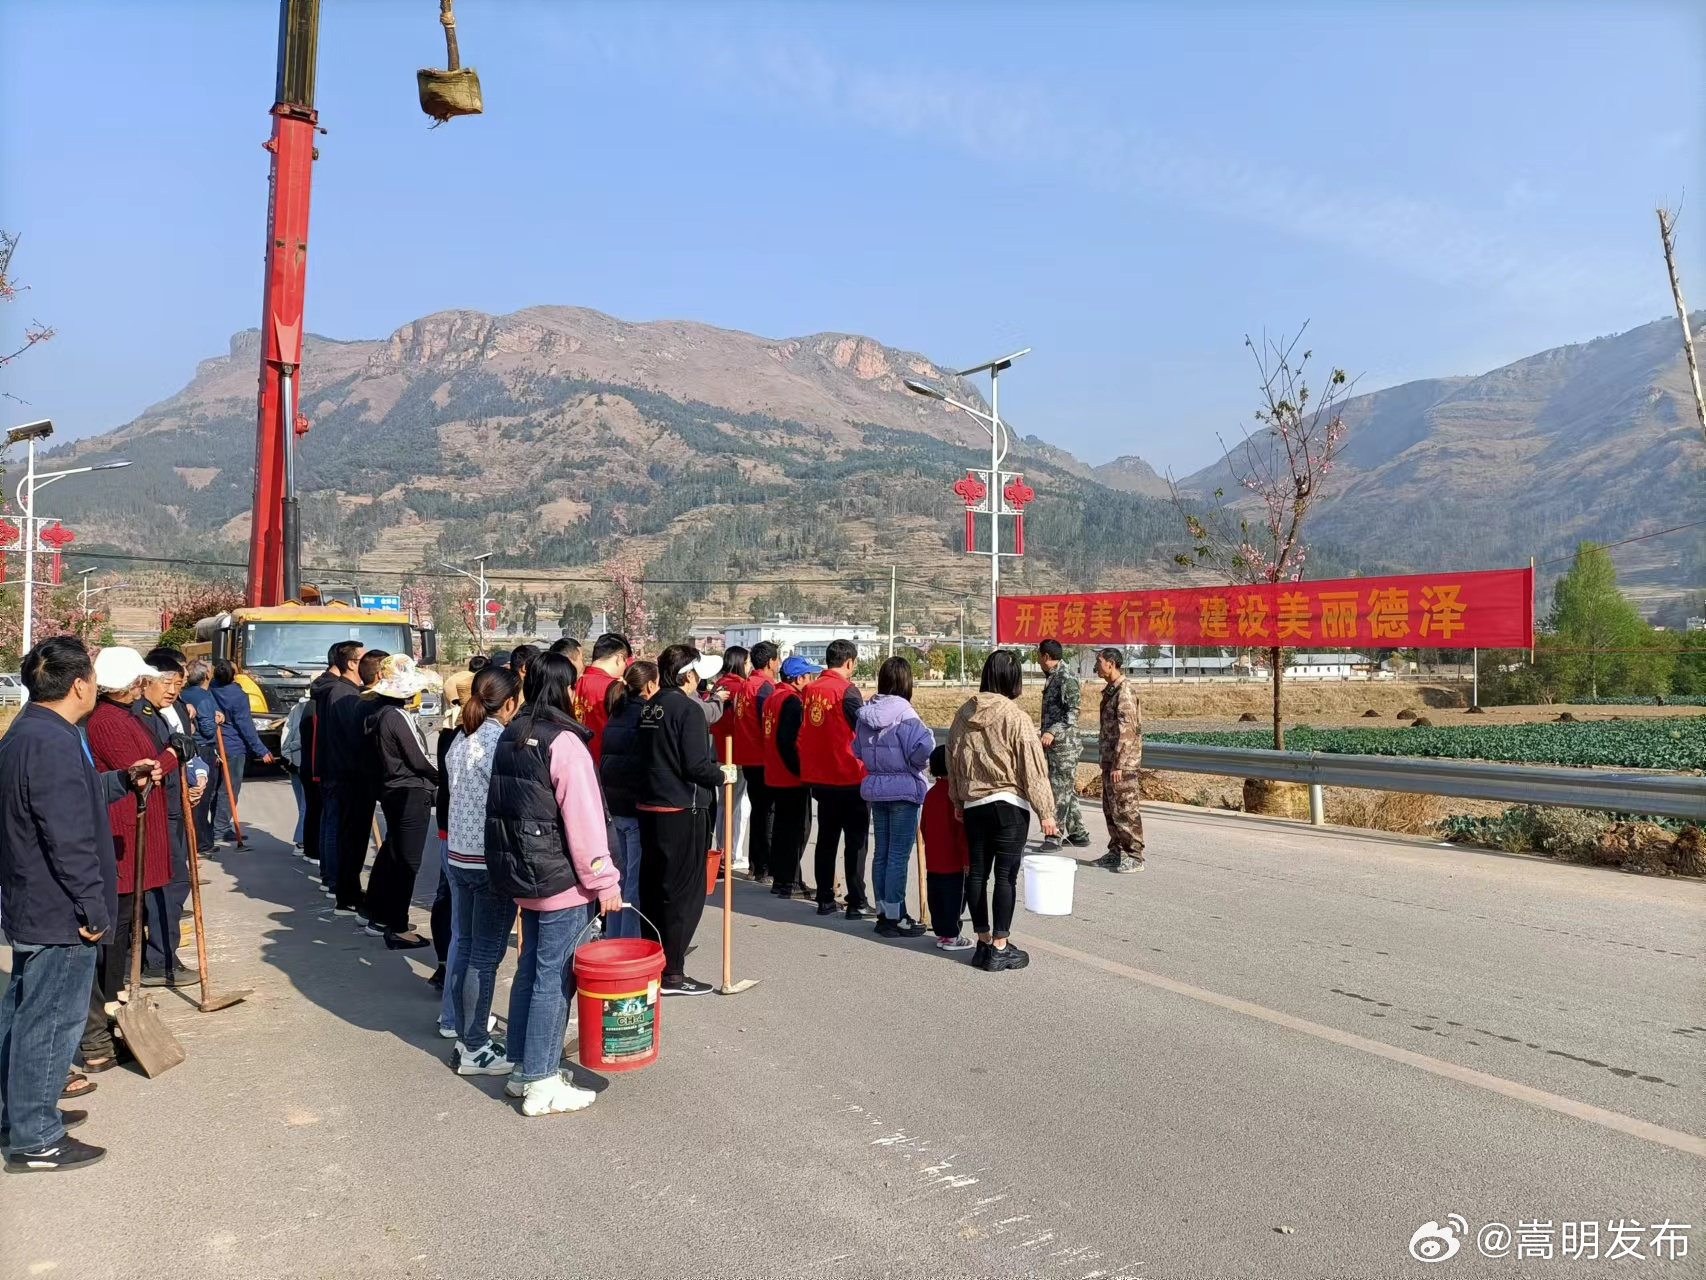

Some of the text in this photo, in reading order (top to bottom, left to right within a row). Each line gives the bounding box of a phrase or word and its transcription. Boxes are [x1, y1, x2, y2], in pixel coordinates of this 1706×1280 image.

[1014, 584, 1468, 640] 开展绿美行动 建设美丽德泽
